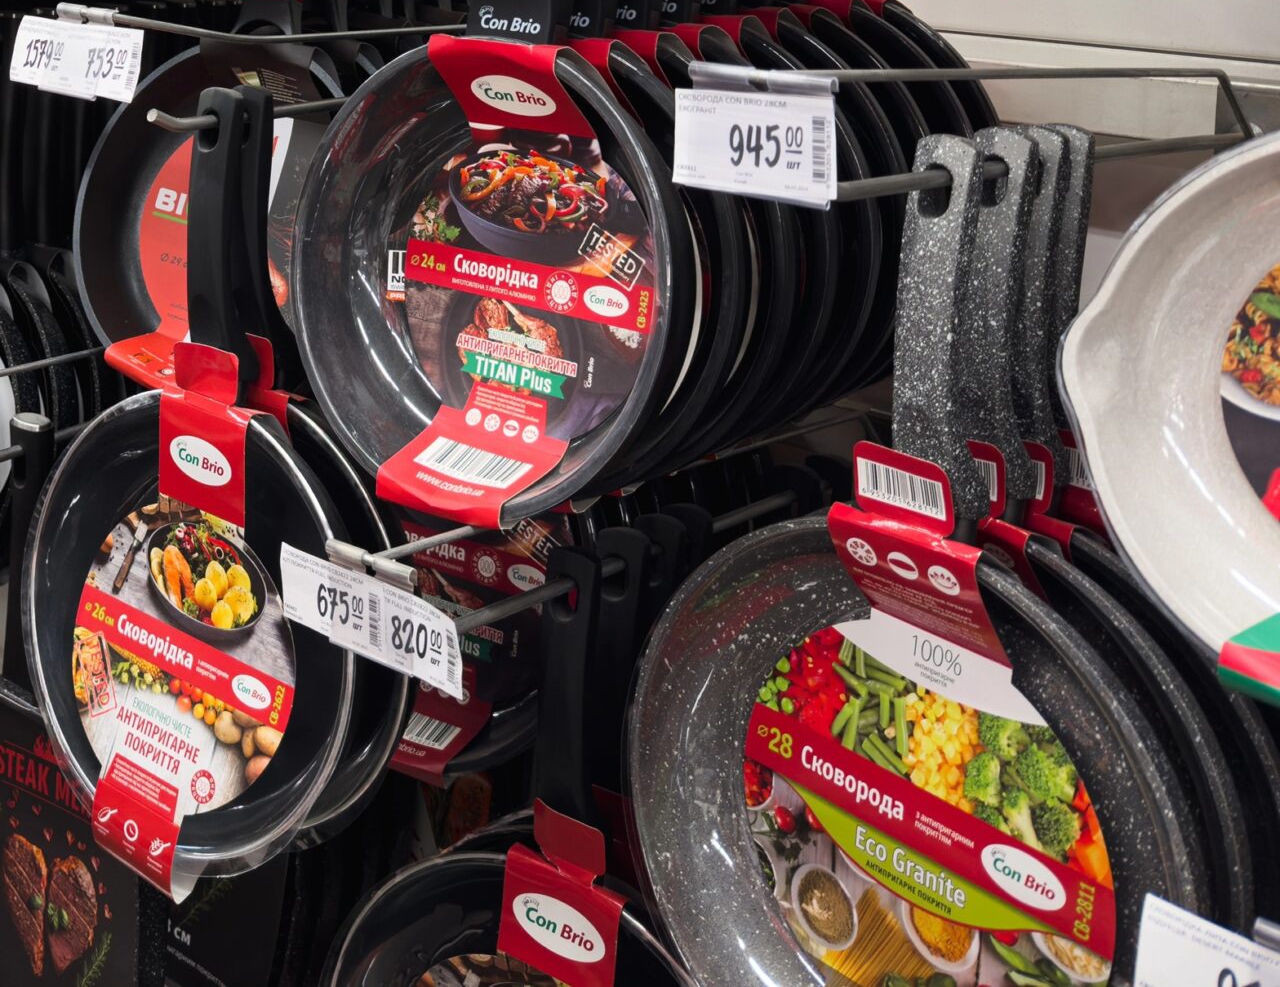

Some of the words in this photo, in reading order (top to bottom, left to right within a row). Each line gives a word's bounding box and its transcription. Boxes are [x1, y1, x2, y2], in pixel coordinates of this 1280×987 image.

[480, 13, 508, 31] Con
[510, 17, 541, 35] Brio
[23, 39, 54, 68] 1579
[85, 48, 114, 78] 753
[116, 50, 127, 65] 00
[484, 86, 515, 102] Con
[517, 91, 547, 107] Brio
[678, 94, 723, 103] СКОВОРОДА
[743, 99, 762, 107] BRIO
[729, 124, 781, 168] 945
[785, 126, 803, 148] 00
[421, 253, 435, 269] 24
[435, 262, 445, 272] см
[453, 254, 539, 289] Сковорідка
[589, 231, 637, 275] TESTED
[452, 277, 484, 290] ВИГОТОВЛЕНА
[489, 285, 508, 295] ЛИТОГО
[509, 291, 537, 301] АЛЮМІНІЮ
[589, 293, 606, 305] Con
[607, 298, 623, 310] Brio
[636, 290, 649, 329] CB-2425
[456, 333, 526, 361] АНТИПРИГАРНЕ
[528, 353, 578, 378] ПОКРИТТЯ
[475, 356, 518, 385] TITAN
[523, 371, 552, 394] Plus
[178, 448, 200, 467] Con
[201, 457, 224, 476] Brio
[415, 470, 485, 497] www.conbrio.ua
[512, 570, 528, 582] Con
[317, 583, 349, 625] 675
[352, 595, 364, 615] 00
[92, 605, 106, 621] 26
[116, 614, 194, 670] Сковорідка
[391, 615, 428, 659] 820
[430, 629, 442, 650] 00
[912, 635, 962, 676] 100%
[92, 643, 110, 707] TESTED
[237, 683, 251, 695] Con
[251, 689, 266, 703] Brio
[920, 672, 947, 687] покриття
[132, 697, 172, 727] ЕКОЛОГІЧНО
[172, 720, 192, 738] ЧИСТЕ
[269, 685, 285, 725] CB-2622
[116, 705, 200, 765] АНТИПРИГАРНЕ
[124, 732, 181, 776] ПОКРИТТЯ
[767, 727, 793, 759] 28
[800, 745, 905, 821] Сковорода
[914, 820, 953, 847] покриттям
[920, 814, 975, 850] антипригарним
[853, 824, 888, 863] Eco
[890, 847, 968, 910] Granite
[993, 858, 1022, 882] Con
[1024, 871, 1056, 902] Brio
[865, 860, 918, 898] АНТИПРИГАРНЕ
[917, 889, 953, 916] ПОКРИТТЯ
[524, 906, 557, 934] Con
[560, 923, 595, 952] Brio
[1073, 881, 1096, 941] CB-2811
